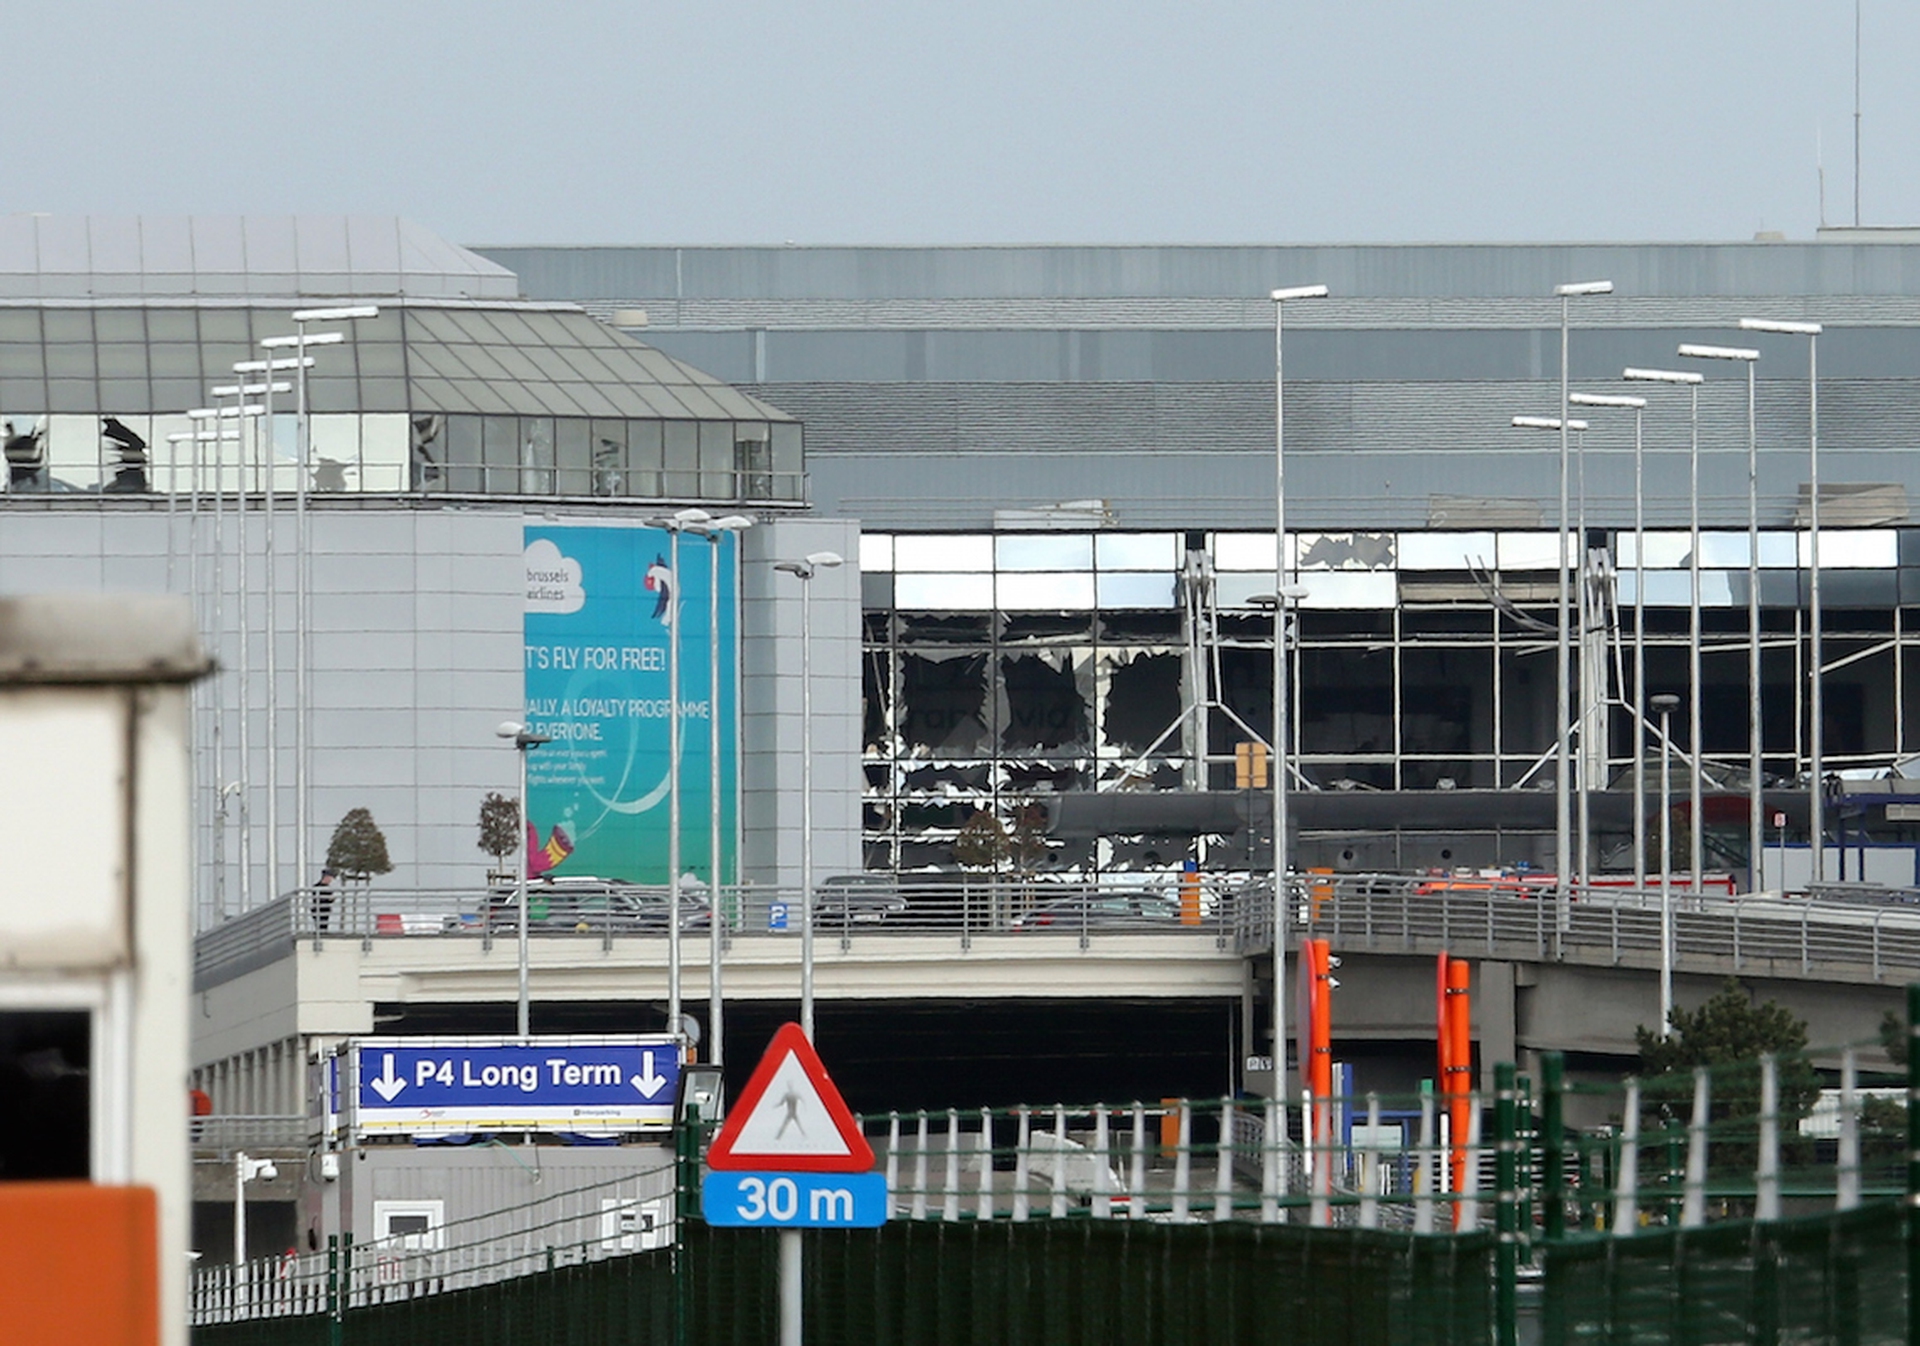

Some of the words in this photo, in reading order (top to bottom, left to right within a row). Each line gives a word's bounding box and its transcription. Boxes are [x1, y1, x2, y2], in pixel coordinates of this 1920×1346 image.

[526, 568, 569, 583] brussels
[526, 586, 565, 600] airlines
[553, 646, 580, 669] FLY
[584, 647, 618, 670] FOR
[621, 647, 666, 671] FREE!
[560, 698, 571, 716] A
[573, 698, 627, 718] LOYALTY
[416, 1060, 454, 1087] P4
[463, 1060, 538, 1092] Long
[546, 1059, 621, 1085] Term
[736, 1176, 798, 1222] 30
[810, 1188, 853, 1221] m
